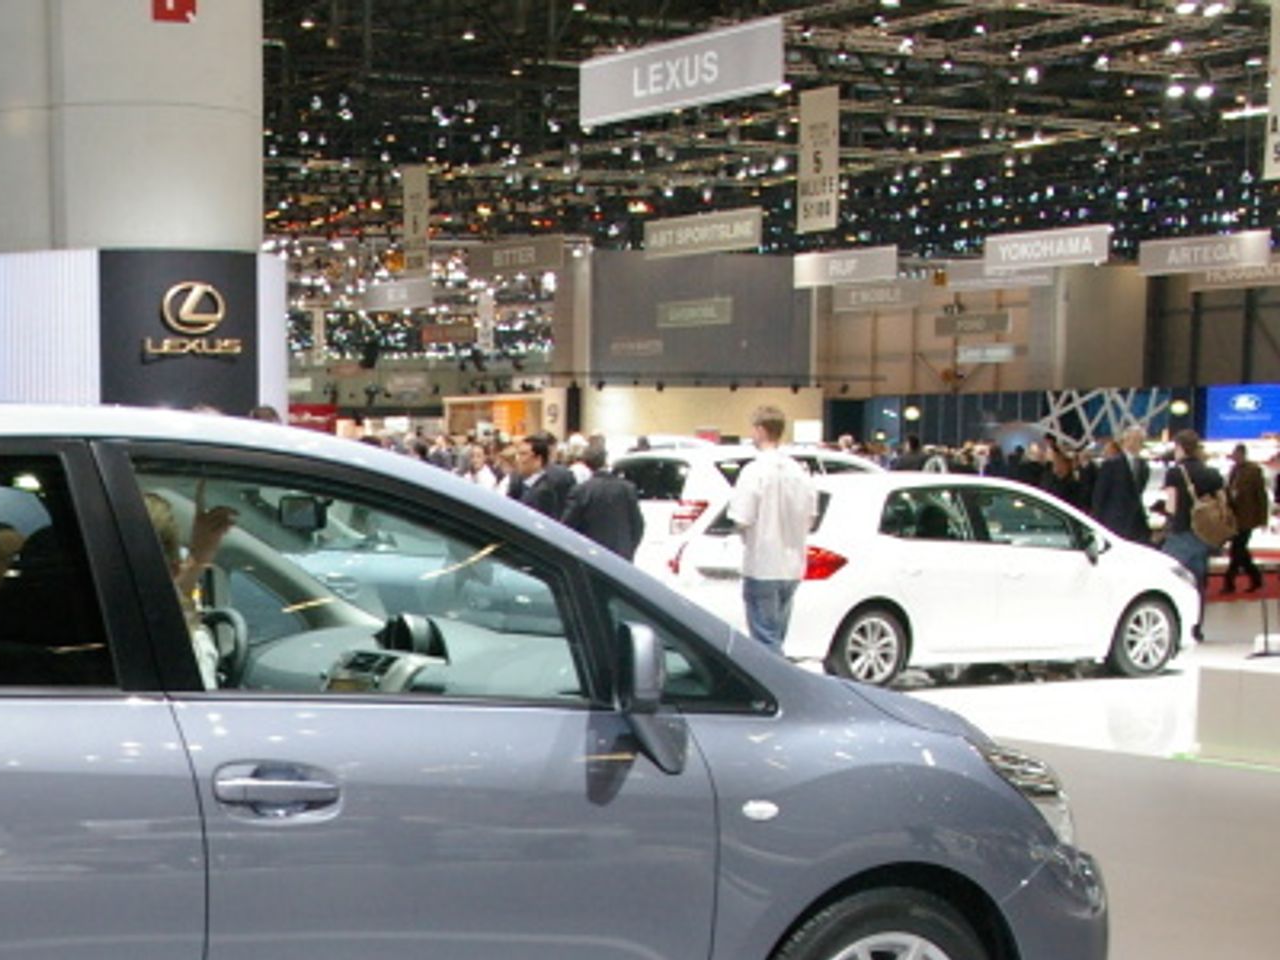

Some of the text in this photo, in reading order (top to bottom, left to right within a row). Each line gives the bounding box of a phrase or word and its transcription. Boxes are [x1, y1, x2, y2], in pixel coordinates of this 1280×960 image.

[632, 51, 719, 98] LEXUS
[999, 236, 1093, 262] YOKOHAMA
[1167, 243, 1239, 265] ARTEGA
[829, 259, 858, 277] RUF
[145, 337, 242, 354] LEXUS
